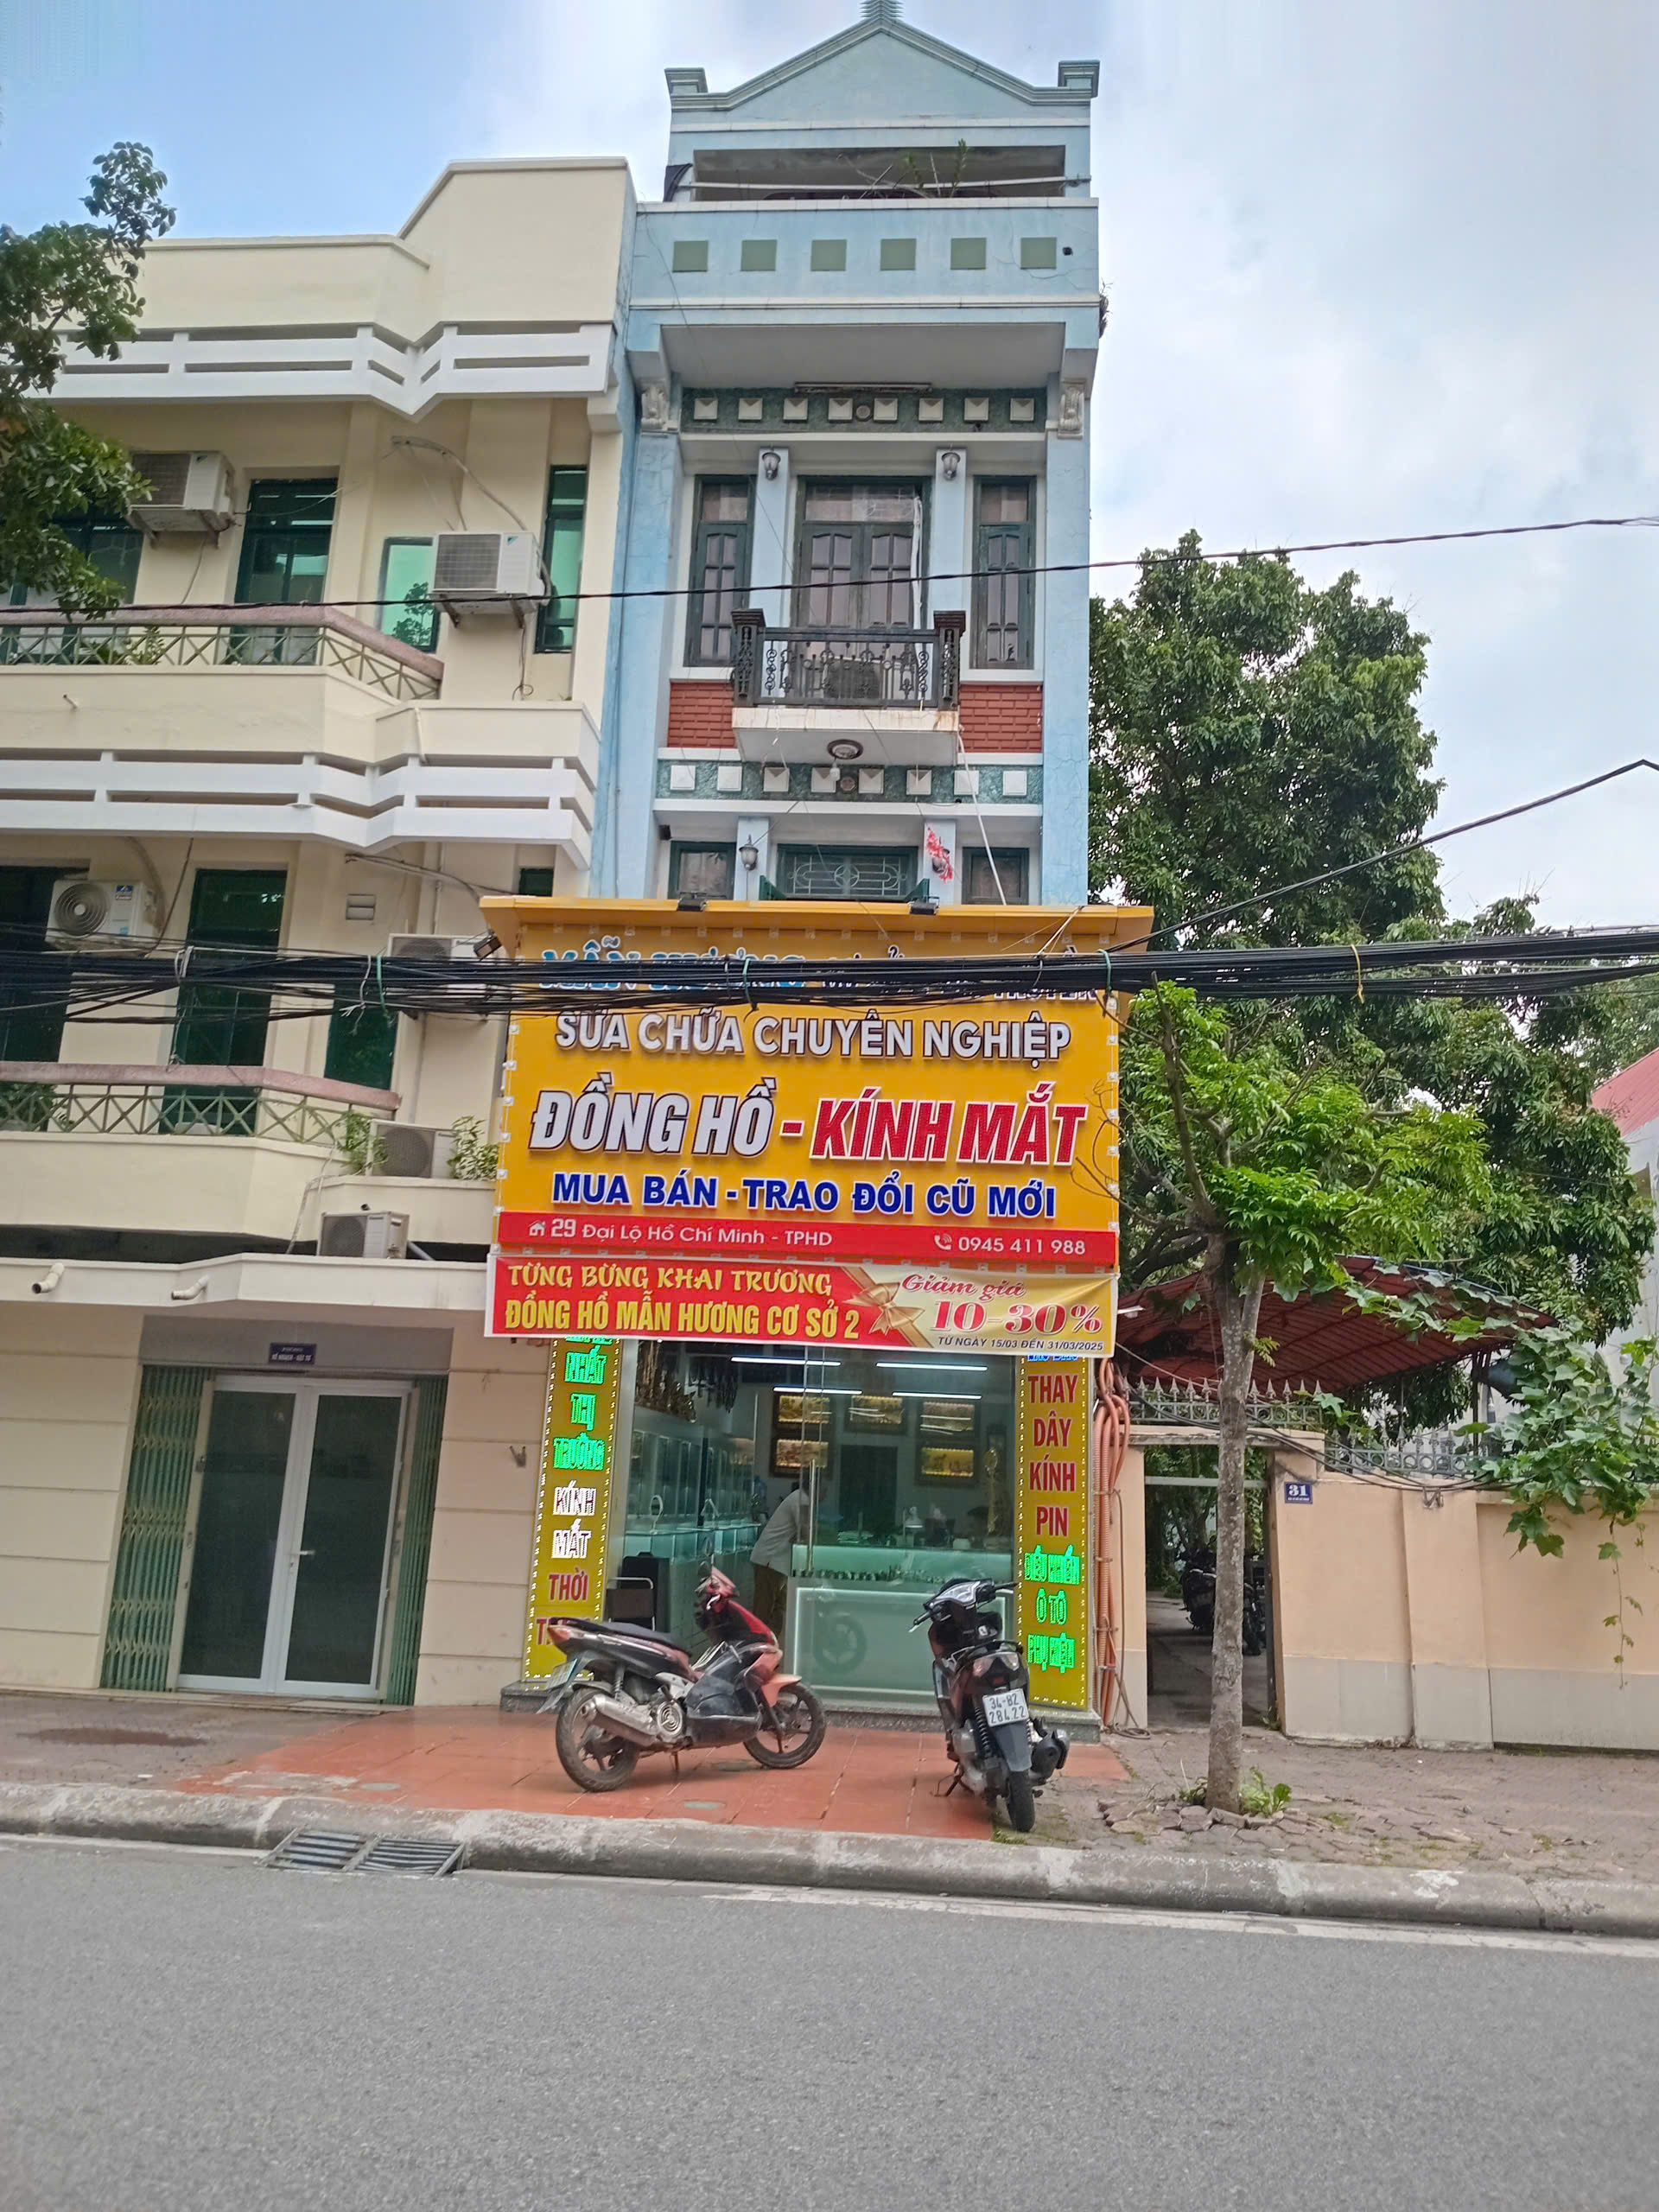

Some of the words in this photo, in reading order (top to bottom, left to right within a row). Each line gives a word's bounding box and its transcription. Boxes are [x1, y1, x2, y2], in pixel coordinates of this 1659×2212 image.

[638, 1007, 745, 1055] CHỮA
[753, 1008, 912, 1058] CHUYÊN
[924, 1010, 1071, 1069] NGHIỆP
[528, 1072, 691, 1156] ĐỒNG
[692, 1077, 778, 1158] HỒ
[809, 1086, 956, 1162] KÍNH
[957, 1081, 1090, 1166] MẮT
[551, 1172, 632, 1206] MUA
[642, 1169, 719, 1208] BÁN
[742, 1177, 839, 1211] TRAO
[852, 1170, 915, 1215] ĐỔI
[926, 1178, 976, 1217] CŨ
[988, 1179, 1057, 1218] MỚI
[551, 1218, 576, 1237] 29
[582, 1224, 614, 1241] Đại
[620, 1224, 643, 1243] Lộ
[648, 1224, 674, 1242] Hồ
[679, 1226, 714, 1243] Chí
[719, 1229, 766, 1244] Minh
[785, 1230, 832, 1246] TPHD
[958, 1236, 1005, 1253] 0945
[1010, 1237, 1046, 1254] 411
[1051, 1240, 1086, 1255] 988
[508, 1262, 574, 1287] TỪNG
[582, 1263, 649, 1289] BỪNG
[658, 1267, 722, 1291] KHAI
[731, 1268, 832, 1296] TRƯƠNG
[901, 1273, 976, 1296] Giảm
[978, 1279, 1027, 1302] giá
[505, 1290, 570, 1330] ĐỒNG
[577, 1290, 609, 1331] HỒ
[616, 1289, 671, 1332] MẪN
[677, 1300, 760, 1335] HƯƠNG
[766, 1303, 800, 1336] CƠ
[805, 1299, 838, 1338] SỞ
[844, 1309, 860, 1339] 2
[955, 1336, 987, 1347] NGÀY
[991, 1339, 1018, 1348] 15/03
[1020, 1337, 1044, 1349] ĐẾN
[1047, 1341, 1103, 1351] 31/03/2025
[1028, 1375, 1078, 1404] THAY
[1033, 1410, 1071, 1447] DÂY
[1029, 1454, 1076, 1492] KÍNH
[552, 1480, 597, 1516] KÍNH
[1288, 1484, 1308, 1497] 31
[551, 1518, 592, 1559] MẮT
[1036, 1506, 1068, 1537] PIN
[548, 1567, 588, 1602] THỜI
[989, 1694, 1020, 1710] 34-B2
[989, 1706, 1027, 1724] 284.22
